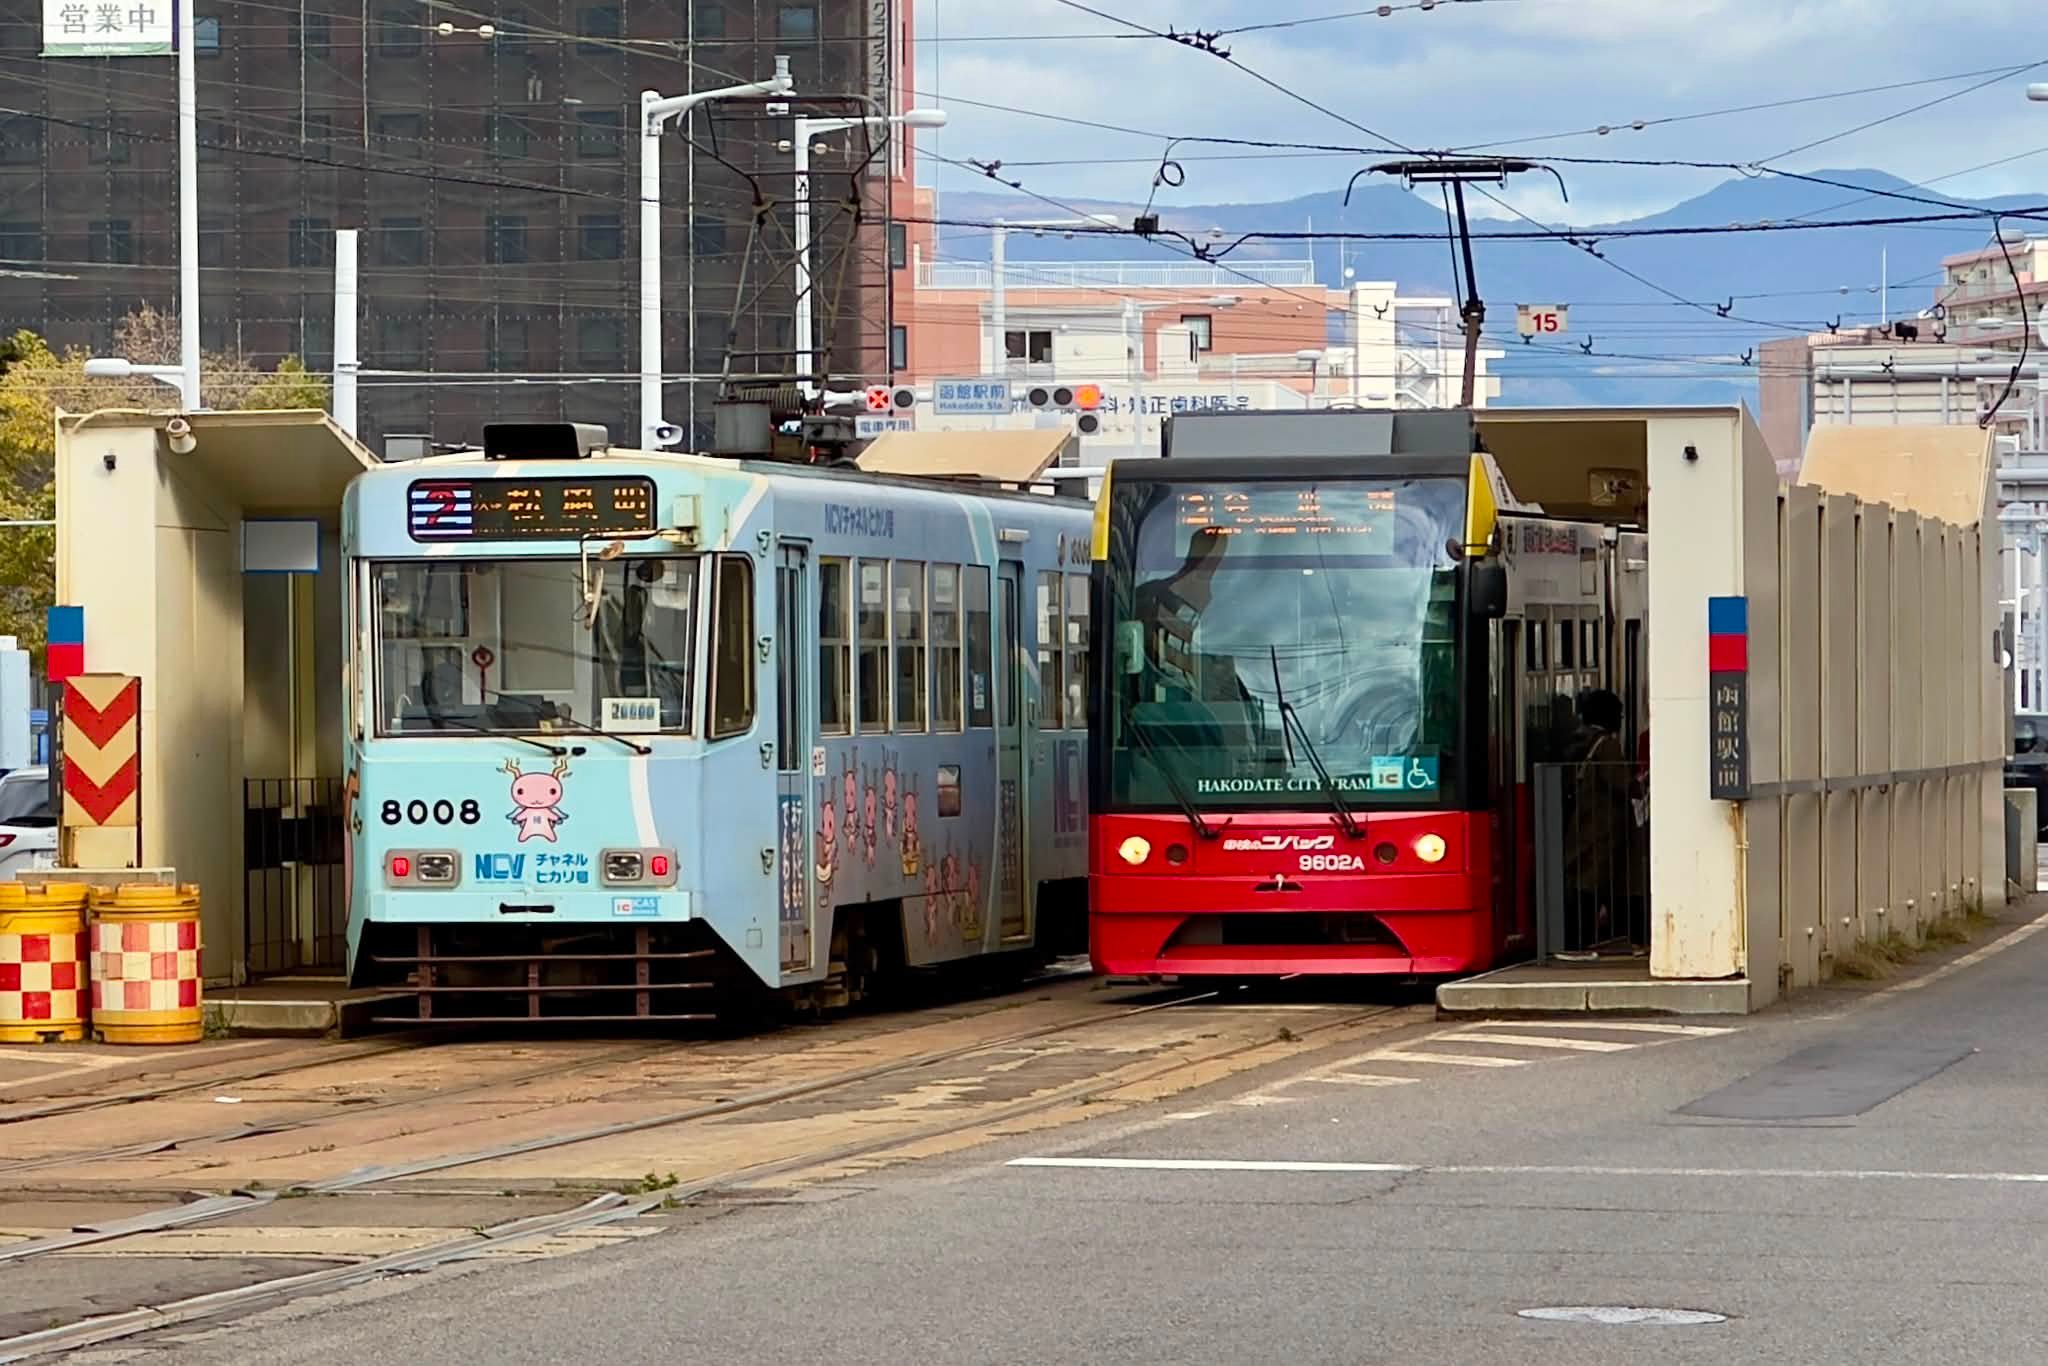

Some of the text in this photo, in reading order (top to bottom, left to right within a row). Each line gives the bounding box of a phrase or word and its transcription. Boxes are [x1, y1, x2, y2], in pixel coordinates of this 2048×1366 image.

[59, 3, 155, 33] 営業中
[1533, 313, 1558, 332] 15
[940, 384, 1005, 399] 函館駅前
[1717, 685, 1739, 787] 函館駅前
[1199, 779, 1284, 792] HAKODATE
[1287, 778, 1323, 791] CITY
[381, 799, 481, 825] 8008
[475, 853, 526, 880] NCV
[536, 853, 588, 867] チャネル
[1299, 854, 1365, 871] 9602A
[536, 869, 589, 884] ヒカリ号
